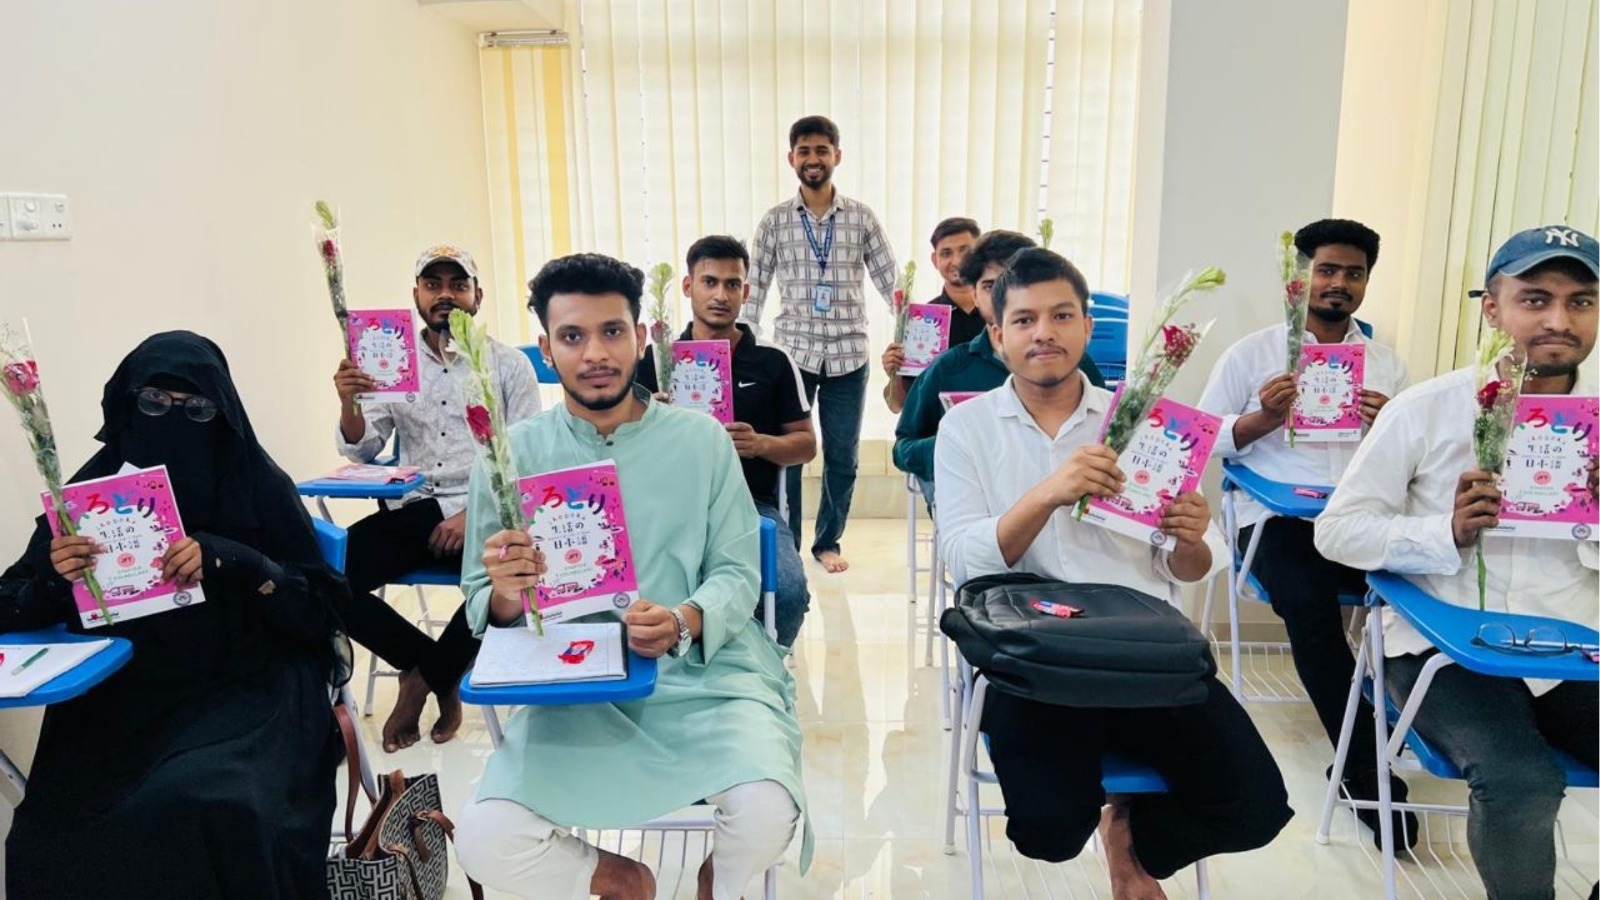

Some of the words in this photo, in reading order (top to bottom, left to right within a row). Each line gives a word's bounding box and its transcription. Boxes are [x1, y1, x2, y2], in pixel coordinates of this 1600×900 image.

[1545, 228, 1579, 247] NY
[1310, 351, 1354, 374] ろどり
[1521, 407, 1593, 441] ろどり
[83, 492, 156, 519] ろどり
[540, 485, 606, 515] ろどり
